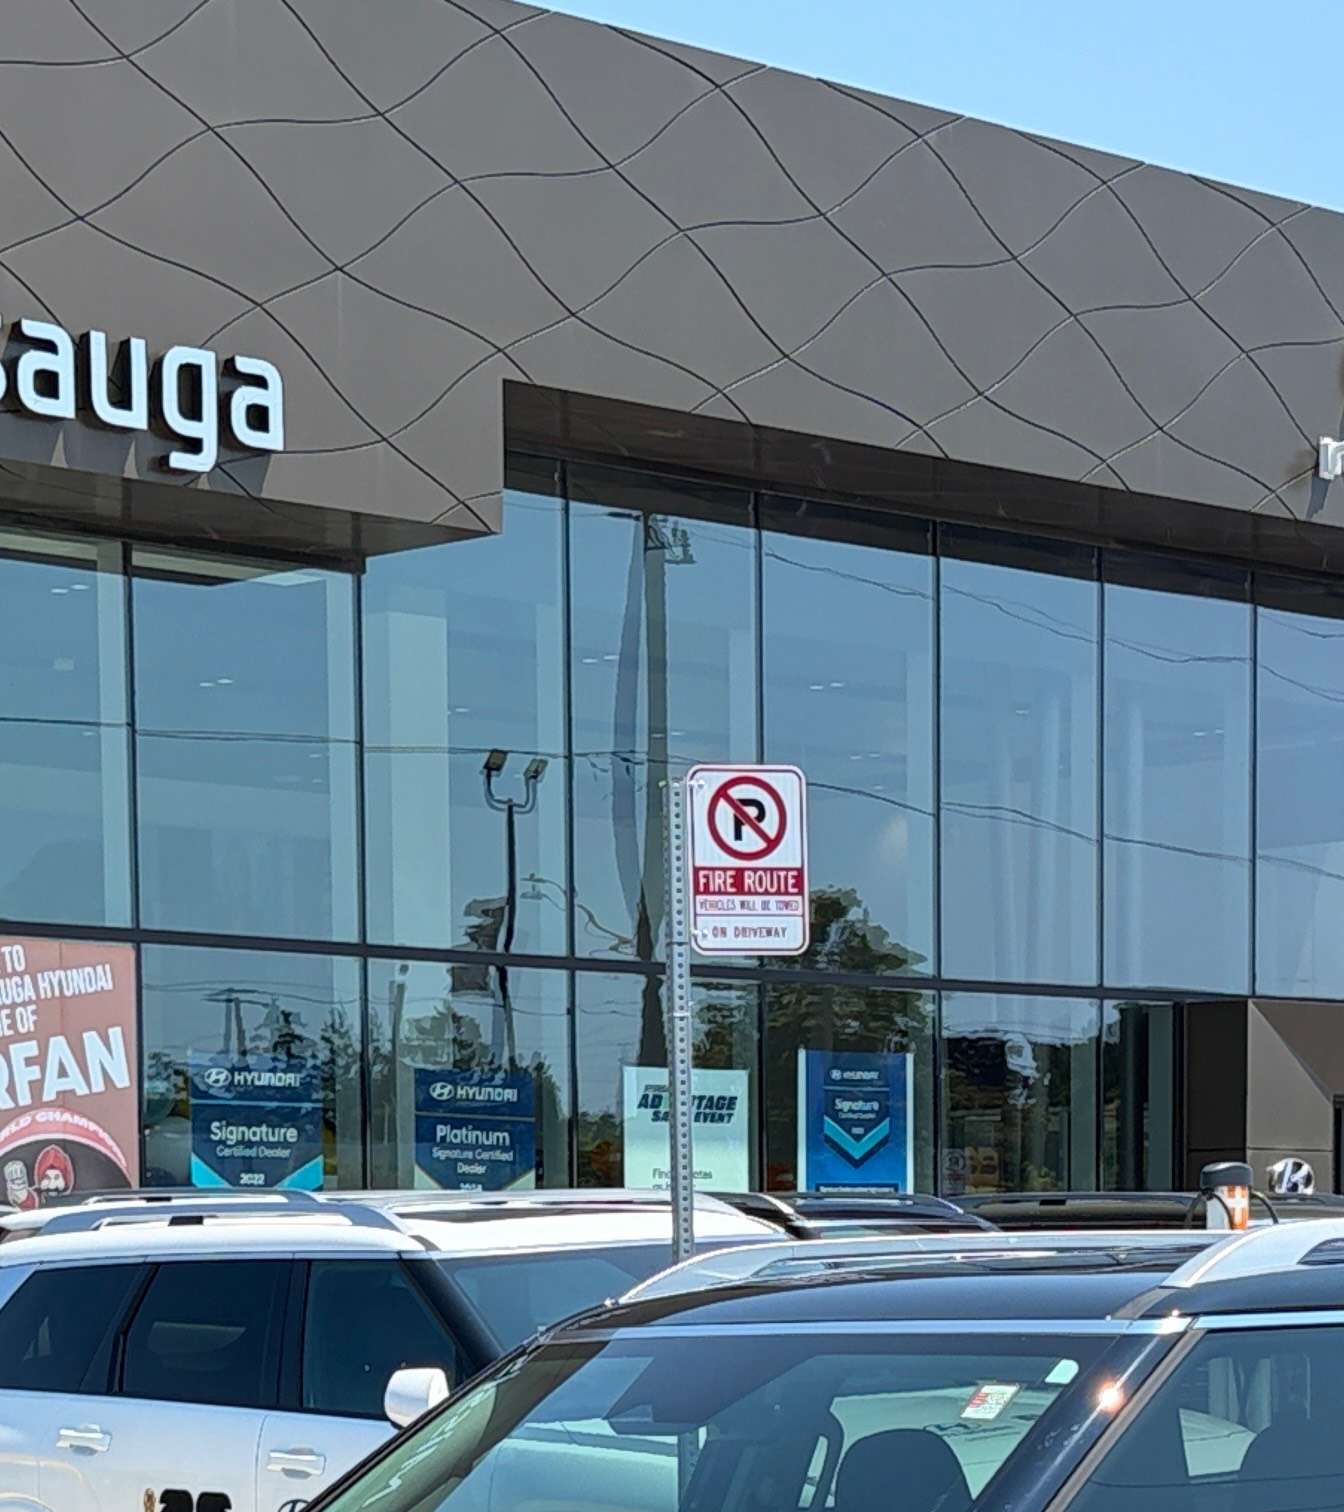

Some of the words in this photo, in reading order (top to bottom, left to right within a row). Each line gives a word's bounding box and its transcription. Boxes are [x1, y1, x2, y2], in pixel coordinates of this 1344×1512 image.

[698, 870, 736, 892] FIRE
[743, 870, 799, 893] ROUTE
[699, 899, 736, 911] VEHICLES
[739, 900, 758, 911] WILL
[775, 900, 799, 911] TOWED
[712, 926, 727, 938] ON
[734, 926, 787, 938] DRIVEWAY
[0, 944, 26, 973] TO
[36, 963, 114, 999] HYUNDAI
[15, 1004, 39, 1033] OF
[234, 1071, 301, 1087] HYUNDAI
[457, 1085, 518, 1102] HYUNDAI
[637, 1093, 738, 1111] ADTAGE
[209, 1120, 299, 1145] Signature
[435, 1123, 510, 1145] Platinum
[216, 1145, 256, 1157] Certified
[258, 1145, 291, 1157] Dealer
[432, 1147, 473, 1160] Signature
[474, 1148, 513, 1161] Certified
[457, 1162, 487, 1174] Dealer
